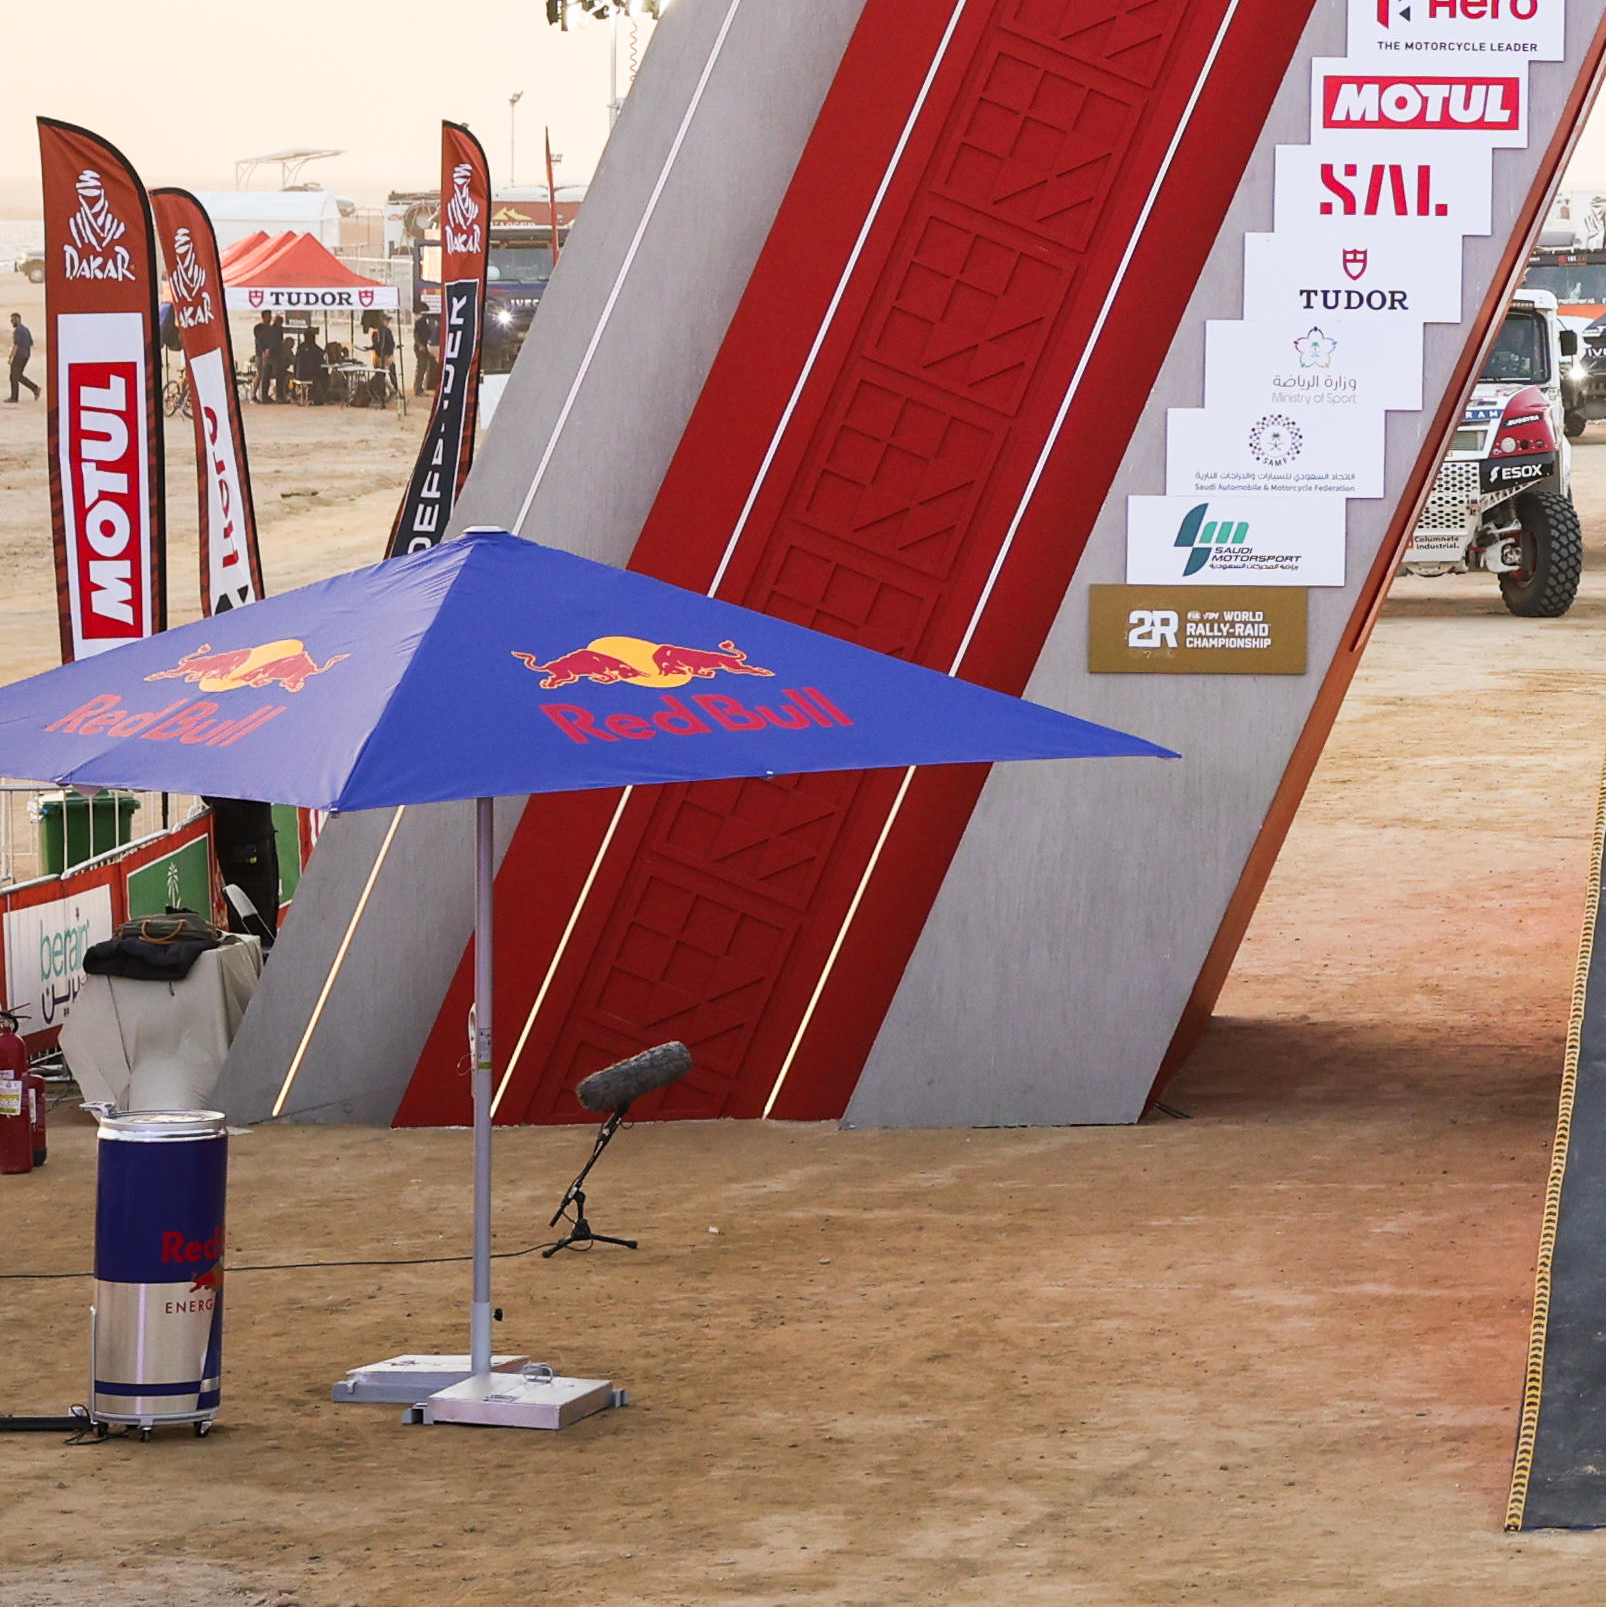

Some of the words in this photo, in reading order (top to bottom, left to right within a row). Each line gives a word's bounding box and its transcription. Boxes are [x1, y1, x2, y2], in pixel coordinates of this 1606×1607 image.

[1377, 41, 1401, 51] THE
[1405, 41, 1487, 52] MOTORCYCLE
[1490, 42, 1538, 53] LEADER
[1331, 82, 1512, 124] MOTUL
[445, 224, 481, 254] DAKAR
[63, 244, 136, 281] DAKAR
[270, 291, 353, 306] TUDOR
[1300, 289, 1409, 311] TUDOR
[178, 292, 215, 328] AKAR
[1272, 374, 1319, 391] الرياضة
[1324, 375, 1357, 391] وزارة
[1272, 392, 1311, 404] Ministry
[1313, 392, 1324, 403] of
[1326, 393, 1357, 406] Sport
[1501, 463, 1543, 480] ESOX
[1195, 483, 1216, 491] Saudi
[1218, 483, 1262, 491] Automobile
[1271, 484, 1313, 493] Motorcycle
[1314, 484, 1356, 492] Federation
[78, 373, 134, 626] MOTUL
[1211, 554, 1302, 563] MOTORSPORT
[1214, 546, 1253, 554] SAUDI
[1223, 611, 1263, 622] WORLD
[1186, 623, 1269, 637] RALLY-RAID
[1186, 637, 1272, 649] CHAMPIONSHIP
[44, 694, 191, 737] Red
[140, 701, 288, 747] Bull
[539, 694, 712, 744] Red
[691, 686, 855, 732] Bull
[161, 1226, 222, 1264] Red
